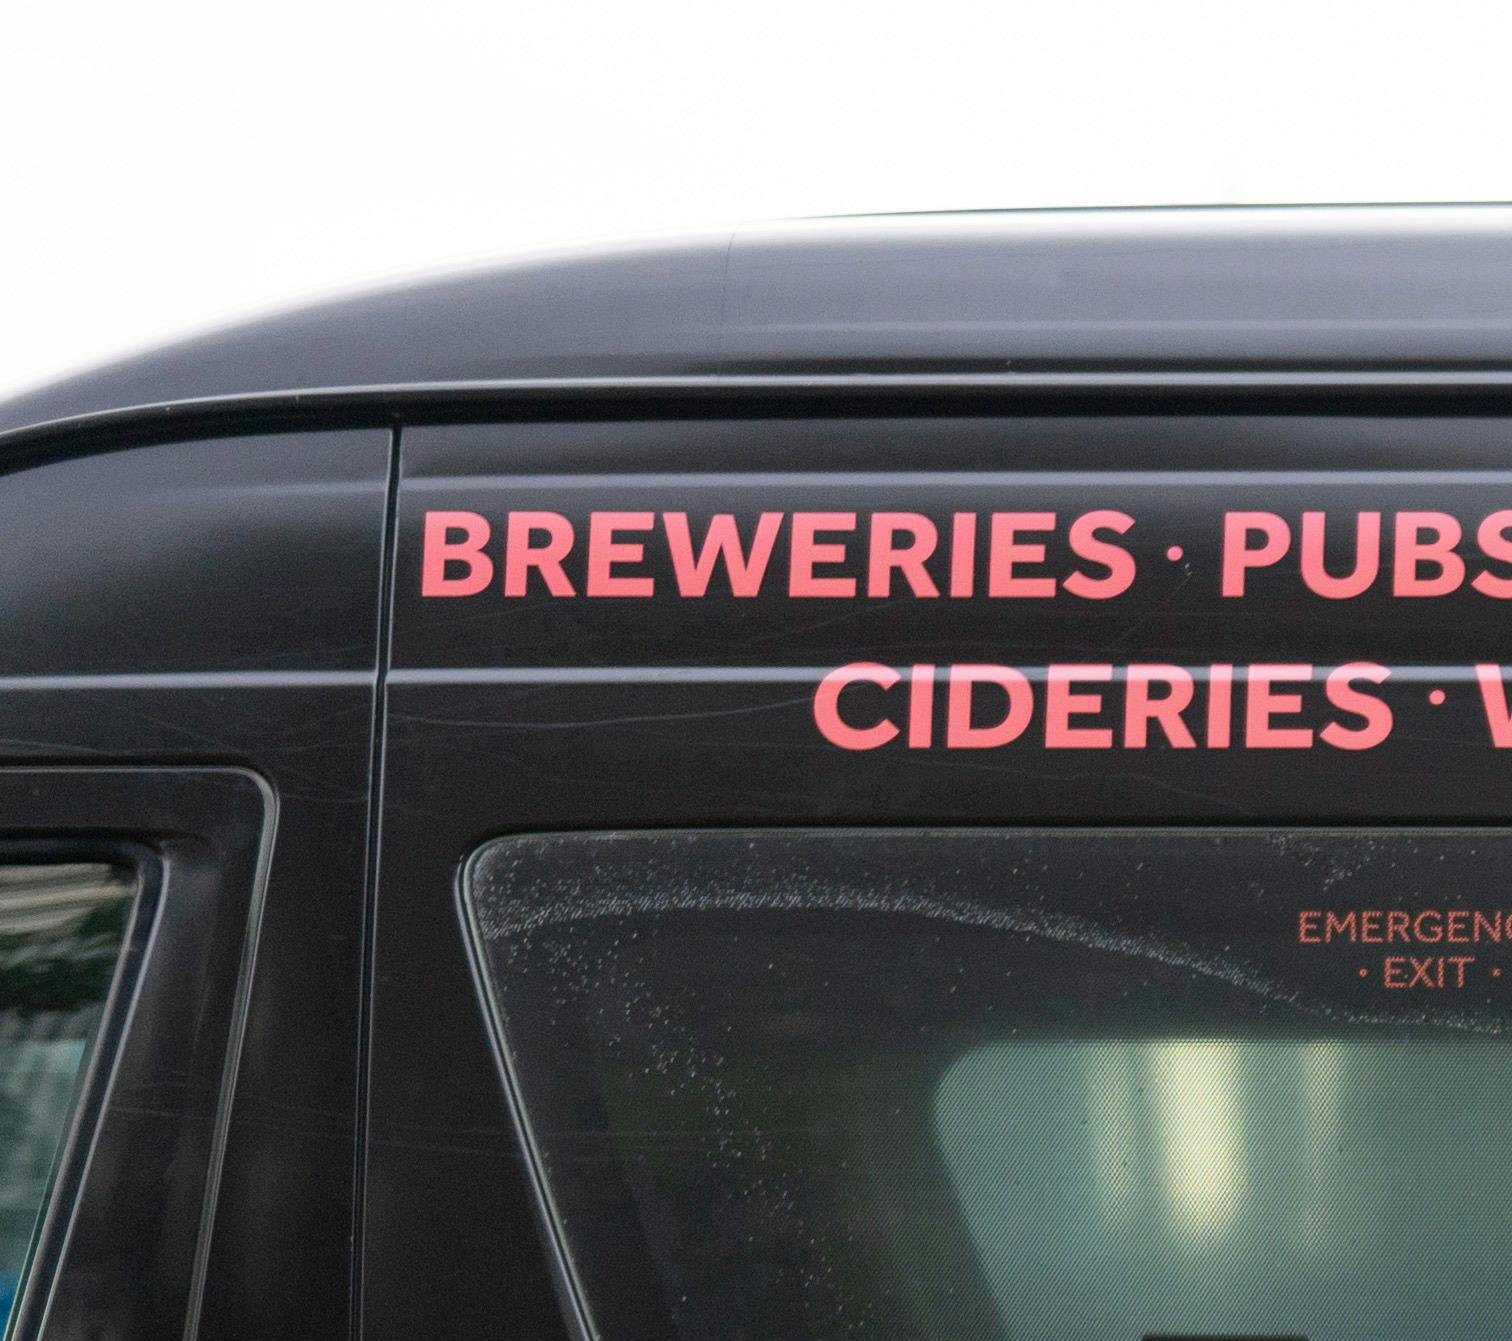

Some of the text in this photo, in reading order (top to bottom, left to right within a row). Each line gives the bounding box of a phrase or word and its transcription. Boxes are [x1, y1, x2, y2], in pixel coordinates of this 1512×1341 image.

[420, 510, 1138, 601] BREWERIES
[812, 660, 1394, 751] CIDERIES
[1383, 956, 1476, 988] EXIT
